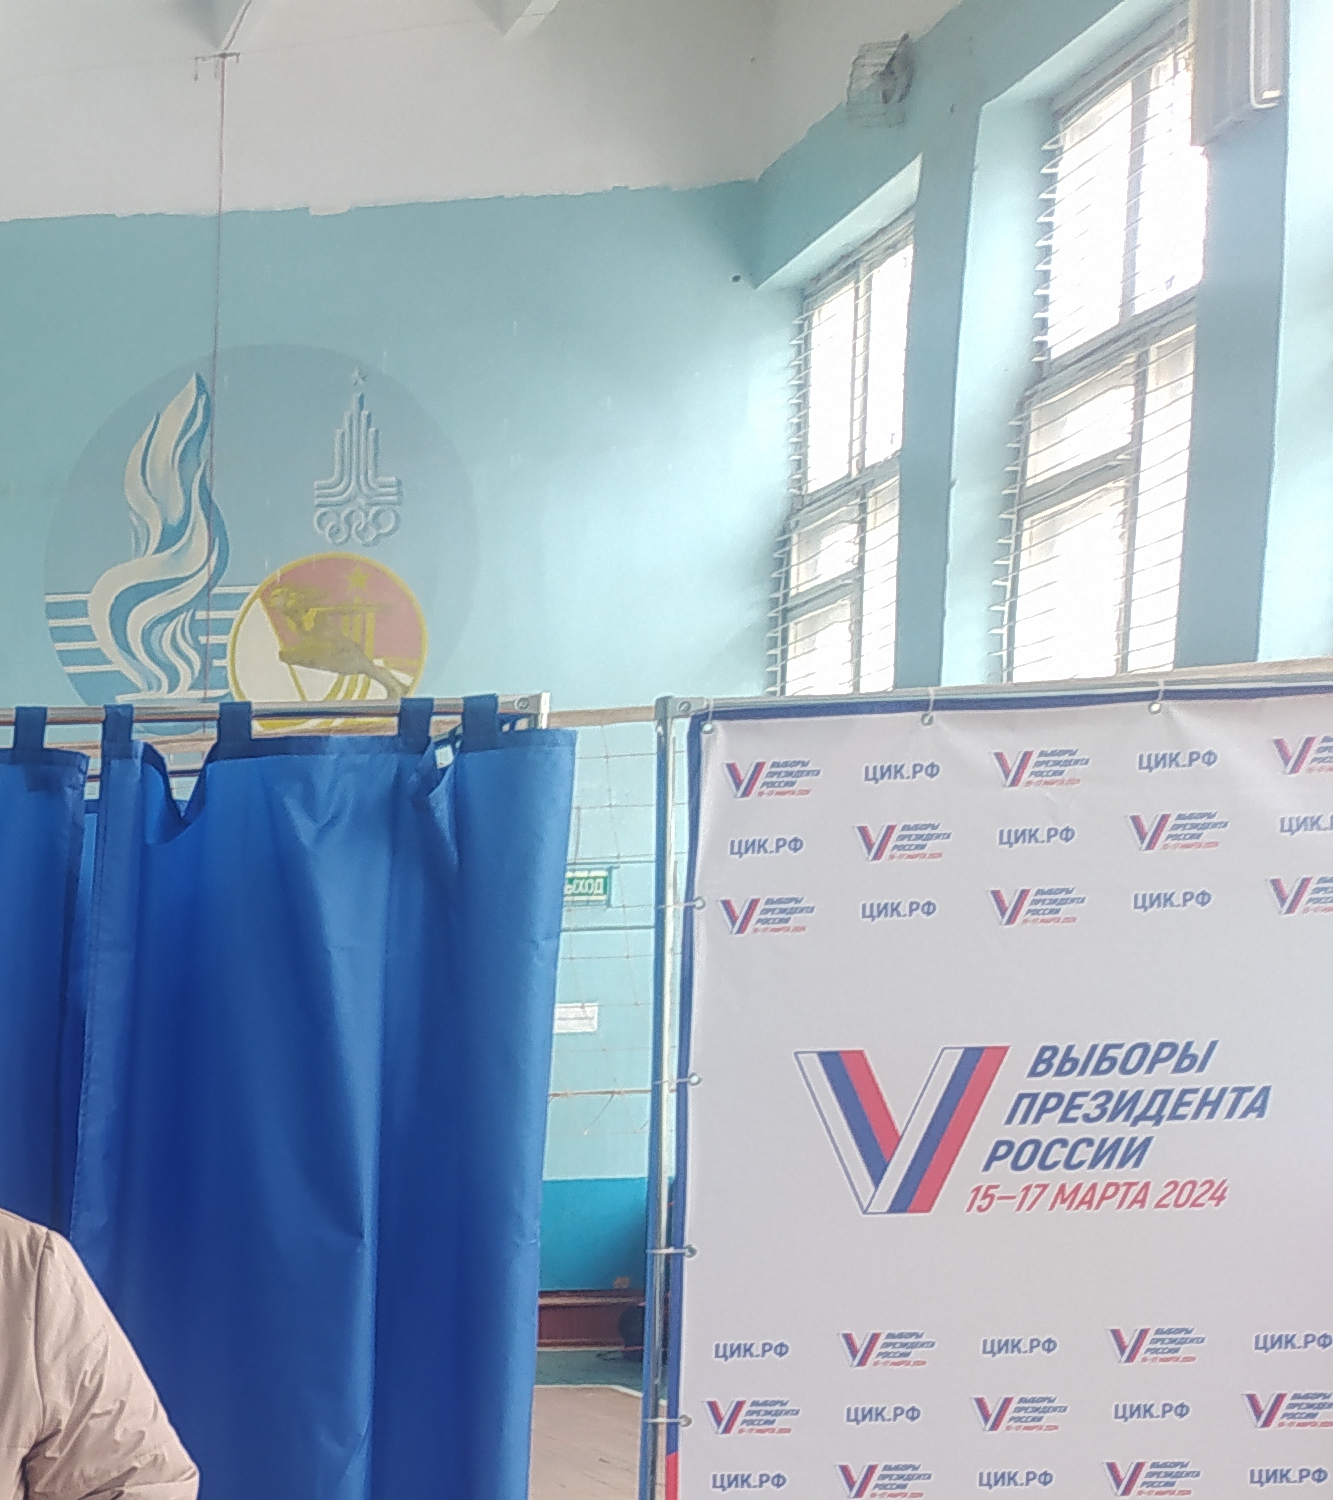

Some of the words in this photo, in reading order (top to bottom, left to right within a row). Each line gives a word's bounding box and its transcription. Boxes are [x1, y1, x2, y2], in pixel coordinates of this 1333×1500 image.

[864, 761, 941, 785] ЦИК.РФ
[1138, 749, 1218, 774] ЦИК.РФ
[1279, 814, 1333, 836] ЦИК.
[729, 836, 804, 859] ЦИК.РФ
[998, 825, 1076, 849] ЦИК.РФ
[861, 900, 937, 923] ЦИК.РФ
[1133, 889, 1212, 913] ЦИК.РФ
[1026, 1040, 1220, 1079] ВЫБОРЫ
[1004, 1085, 1273, 1128] ПРЕЗИДЕНТА
[982, 1136, 1155, 1173] РОССИИ
[1048, 1181, 1153, 1213] МАРТА
[1153, 1179, 1230, 1210] 2024
[714, 1341, 790, 1362] ЦИК.РФ
[981, 1337, 1058, 1358] ЦИК.РФ
[1254, 1332, 1333, 1354] ЦИК.РФ
[845, 1405, 921, 1426] ЦИК.РФ
[1113, 1401, 1191, 1423] ЦИК.РФ
[711, 1472, 787, 1493] ЦИК.РФ
[978, 1469, 1054, 1491] ЦИК.РФ
[1249, 1467, 1329, 1488] ЦИК.РФ
